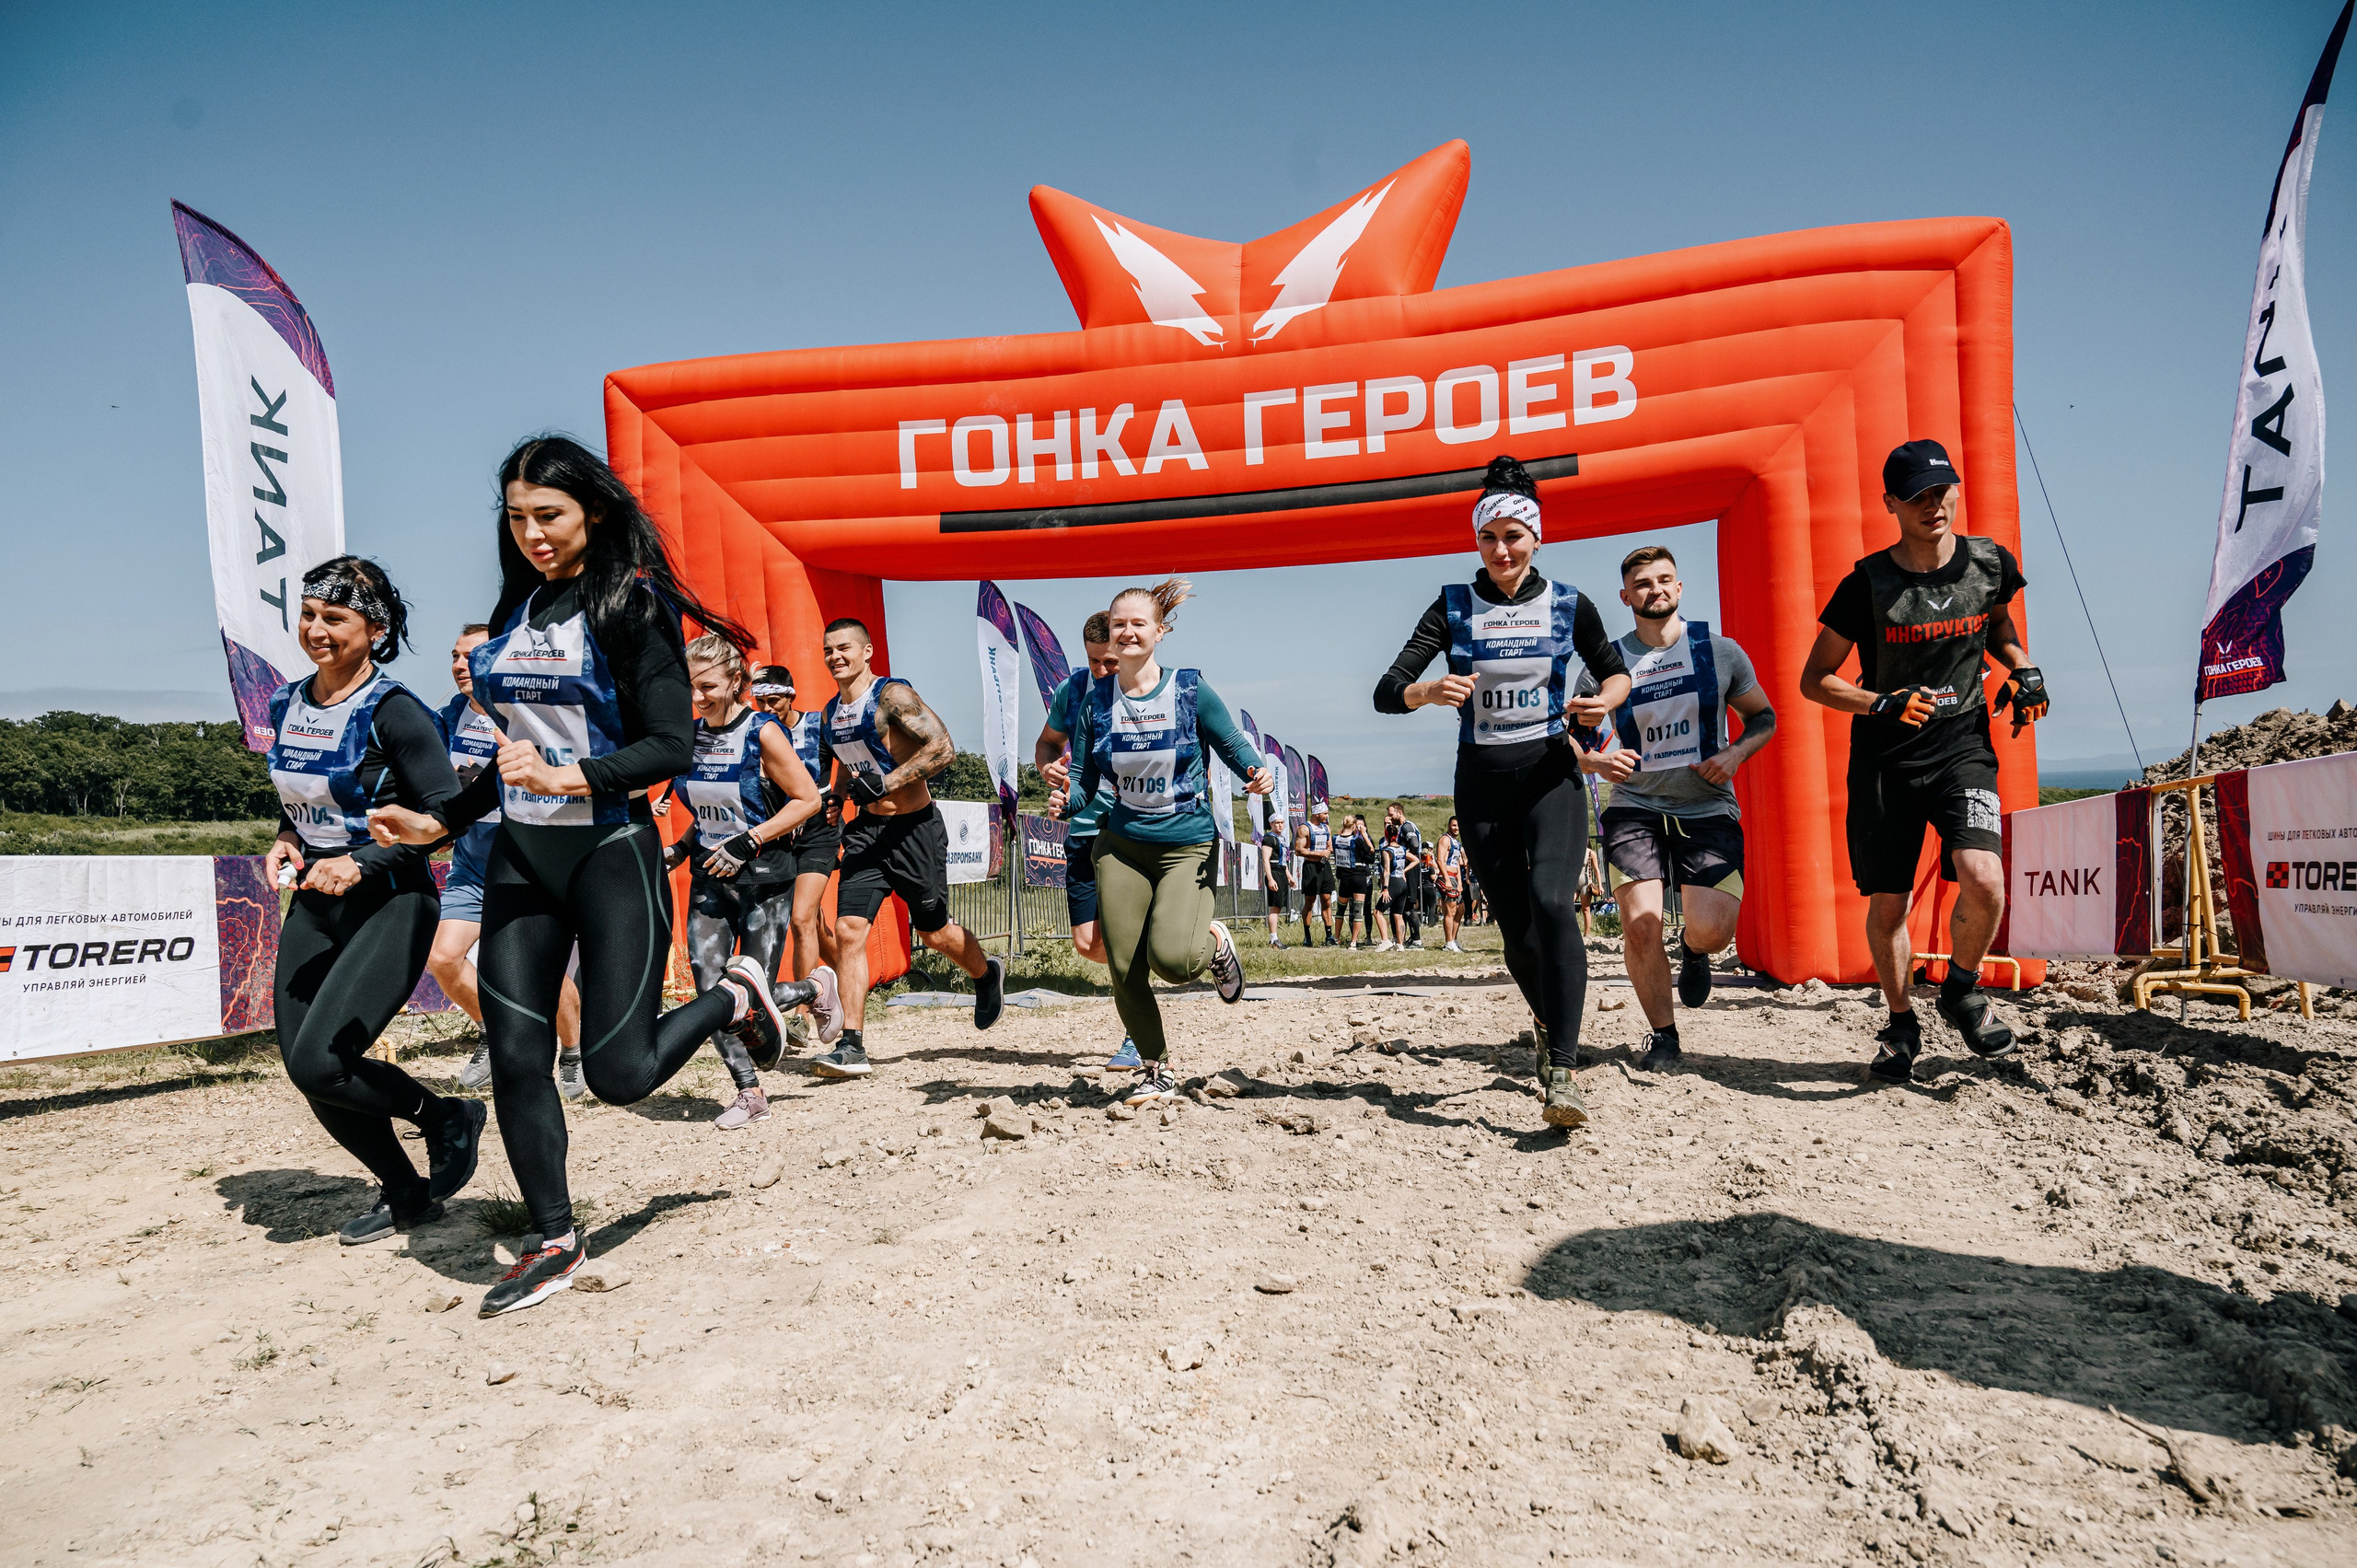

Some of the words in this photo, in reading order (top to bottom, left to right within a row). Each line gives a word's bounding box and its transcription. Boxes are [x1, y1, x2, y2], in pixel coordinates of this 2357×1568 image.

[899, 399, 1210, 489] ГОНКА
[1244, 345, 1637, 465] ГЕРОЕВ
[1485, 637, 1538, 648] КОМАНДНЫЙ
[1499, 648, 1524, 656] СТАРТ
[1636, 668, 1656, 677] ГОНКА
[1658, 661, 1683, 670] ГЕРОЕВ
[2204, 663, 2226, 676] ГОНКА
[2226, 656, 2263, 672] ГЕРОЕВ
[502, 676, 559, 690] КОМАНДНЫЙ
[1641, 677, 1683, 694] КОМАНДНЫЙ
[516, 690, 541, 701] СТАРТ
[1482, 689, 1540, 709] 01103
[1654, 689, 1673, 699] СТАРТ
[1140, 713, 1166, 721] ГЕРОЕВ
[1122, 731, 1164, 743] КОМАНДНЫЙ
[1654, 747, 1698, 759] ГАЗПРОМБАНК
[285, 761, 308, 770] СТАРТ
[1123, 776, 1167, 794] 01109
[2287, 830, 2300, 842] ДЛЯ
[2302, 828, 2336, 840] ЛЕГКОВЫХ
[1028, 839, 1051, 856] ГОНКА
[946, 852, 982, 865] АЗПРОМБАНК
[2025, 866, 2102, 897] TANK
[2292, 861, 2357, 891] TORE
[2293, 902, 2330, 914] УПРАВЛЯЙ
[16, 916, 42, 927] ДЛЯ
[45, 913, 107, 925] ЛЕГКОВЫХ
[110, 909, 193, 923] АВТОМОБИЛЕЙ
[23, 936, 195, 971] TORERO
[23, 977, 85, 993] УПРАВЛЯЙ
[88, 973, 147, 989] ЭНЕРГИЕЙ
